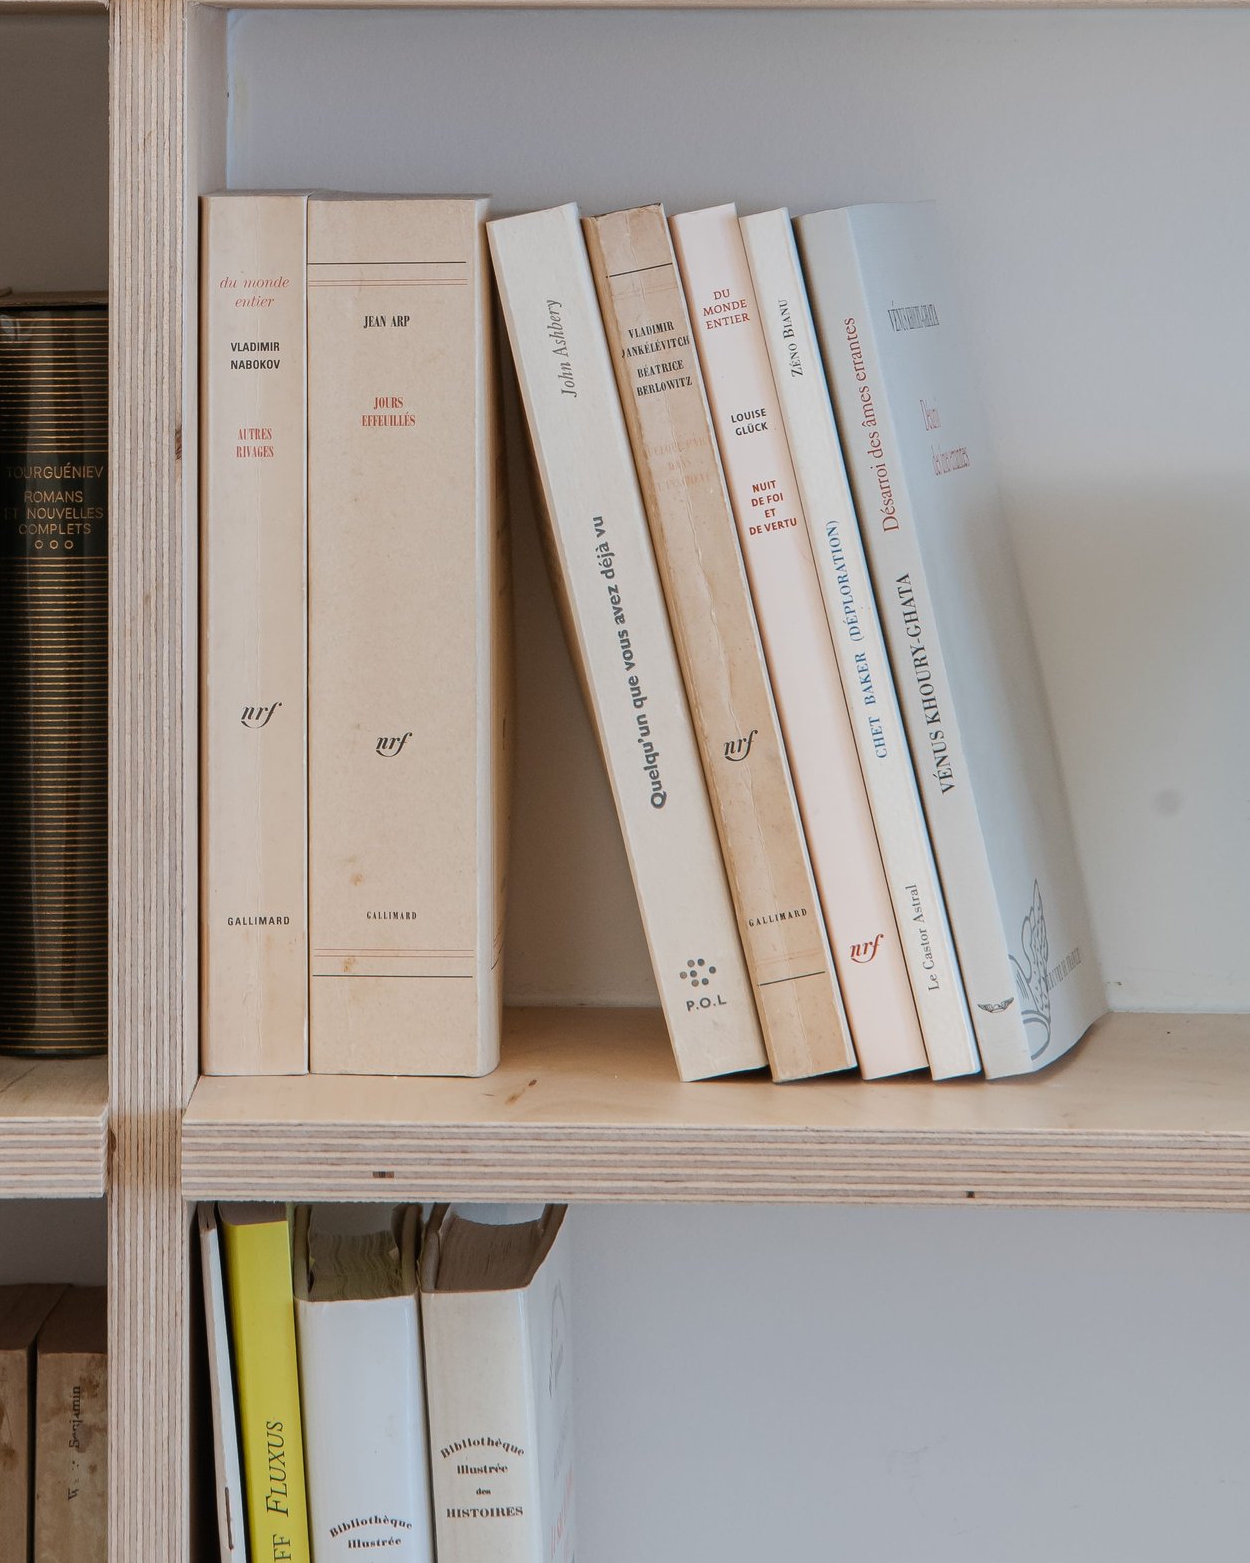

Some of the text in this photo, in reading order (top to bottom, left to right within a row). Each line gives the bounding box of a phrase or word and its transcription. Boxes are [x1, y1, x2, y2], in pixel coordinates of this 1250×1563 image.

[219, 276, 290, 289] du monde
[235, 296, 275, 308] entier
[714, 288, 731, 301] DU
[703, 299, 748, 316] MONDE
[363, 315, 410, 329] JEAN ARP
[628, 321, 675, 339] VLADIMIR
[706, 313, 750, 330] ENTIER
[778, 298, 804, 378] ZÉNO BIANU
[230, 342, 280, 352] VLADIMIR
[547, 299, 577, 398] John Ashbery
[230, 359, 280, 370] NABOKOV
[637, 359, 685, 378] BÉATRICE
[636, 376, 693, 397] BERLOWITZ
[373, 397, 404, 410] JOURS
[362, 412, 416, 427] EFFEUILLÉS
[730, 408, 767, 424] LOUISE
[735, 422, 768, 437] GLÜCK
[844, 317, 900, 533] Désarroi des âmes errantes
[237, 428, 272, 440] AUTRES
[236, 446, 274, 458] RIVAGES
[6, 462, 104, 479] TOURGUÉNIEV
[752, 480, 777, 493] NUIT
[24, 490, 83, 503] ROMANS
[751, 493, 784, 507] DE FOI
[26, 507, 104, 519] NOUVELLES
[764, 508, 776, 518] ET
[18, 523, 92, 535] COMPLETS
[749, 518, 798, 536] DE VERTU
[826, 520, 888, 759] CHET BAKER (DÉPLORATION)
[593, 515, 668, 810] Quelqu'un que vous avez déjà vu
[896, 573, 956, 795] VÉNUS KHOURY-GHATA
[241, 702, 283, 729] nrf
[375, 732, 413, 758] nrf
[724, 729, 758, 762] nrf
[227, 916, 290, 926] GALLIMARD
[366, 910, 417, 920] GALLIMARD
[748, 908, 808, 927] GALLIMARD
[905, 884, 940, 992] Le Castor Astral
[850, 933, 884, 964] nrf
[686, 994, 727, 1012] P.O.L
[440, 1437, 525, 1459] Bibliothèque
[265, 1420, 289, 1517] FLUXUS
[446, 1506, 524, 1519] HISTOIRES
[329, 1514, 413, 1539] Bibliothèque
[347, 1537, 402, 1550] illustrée
